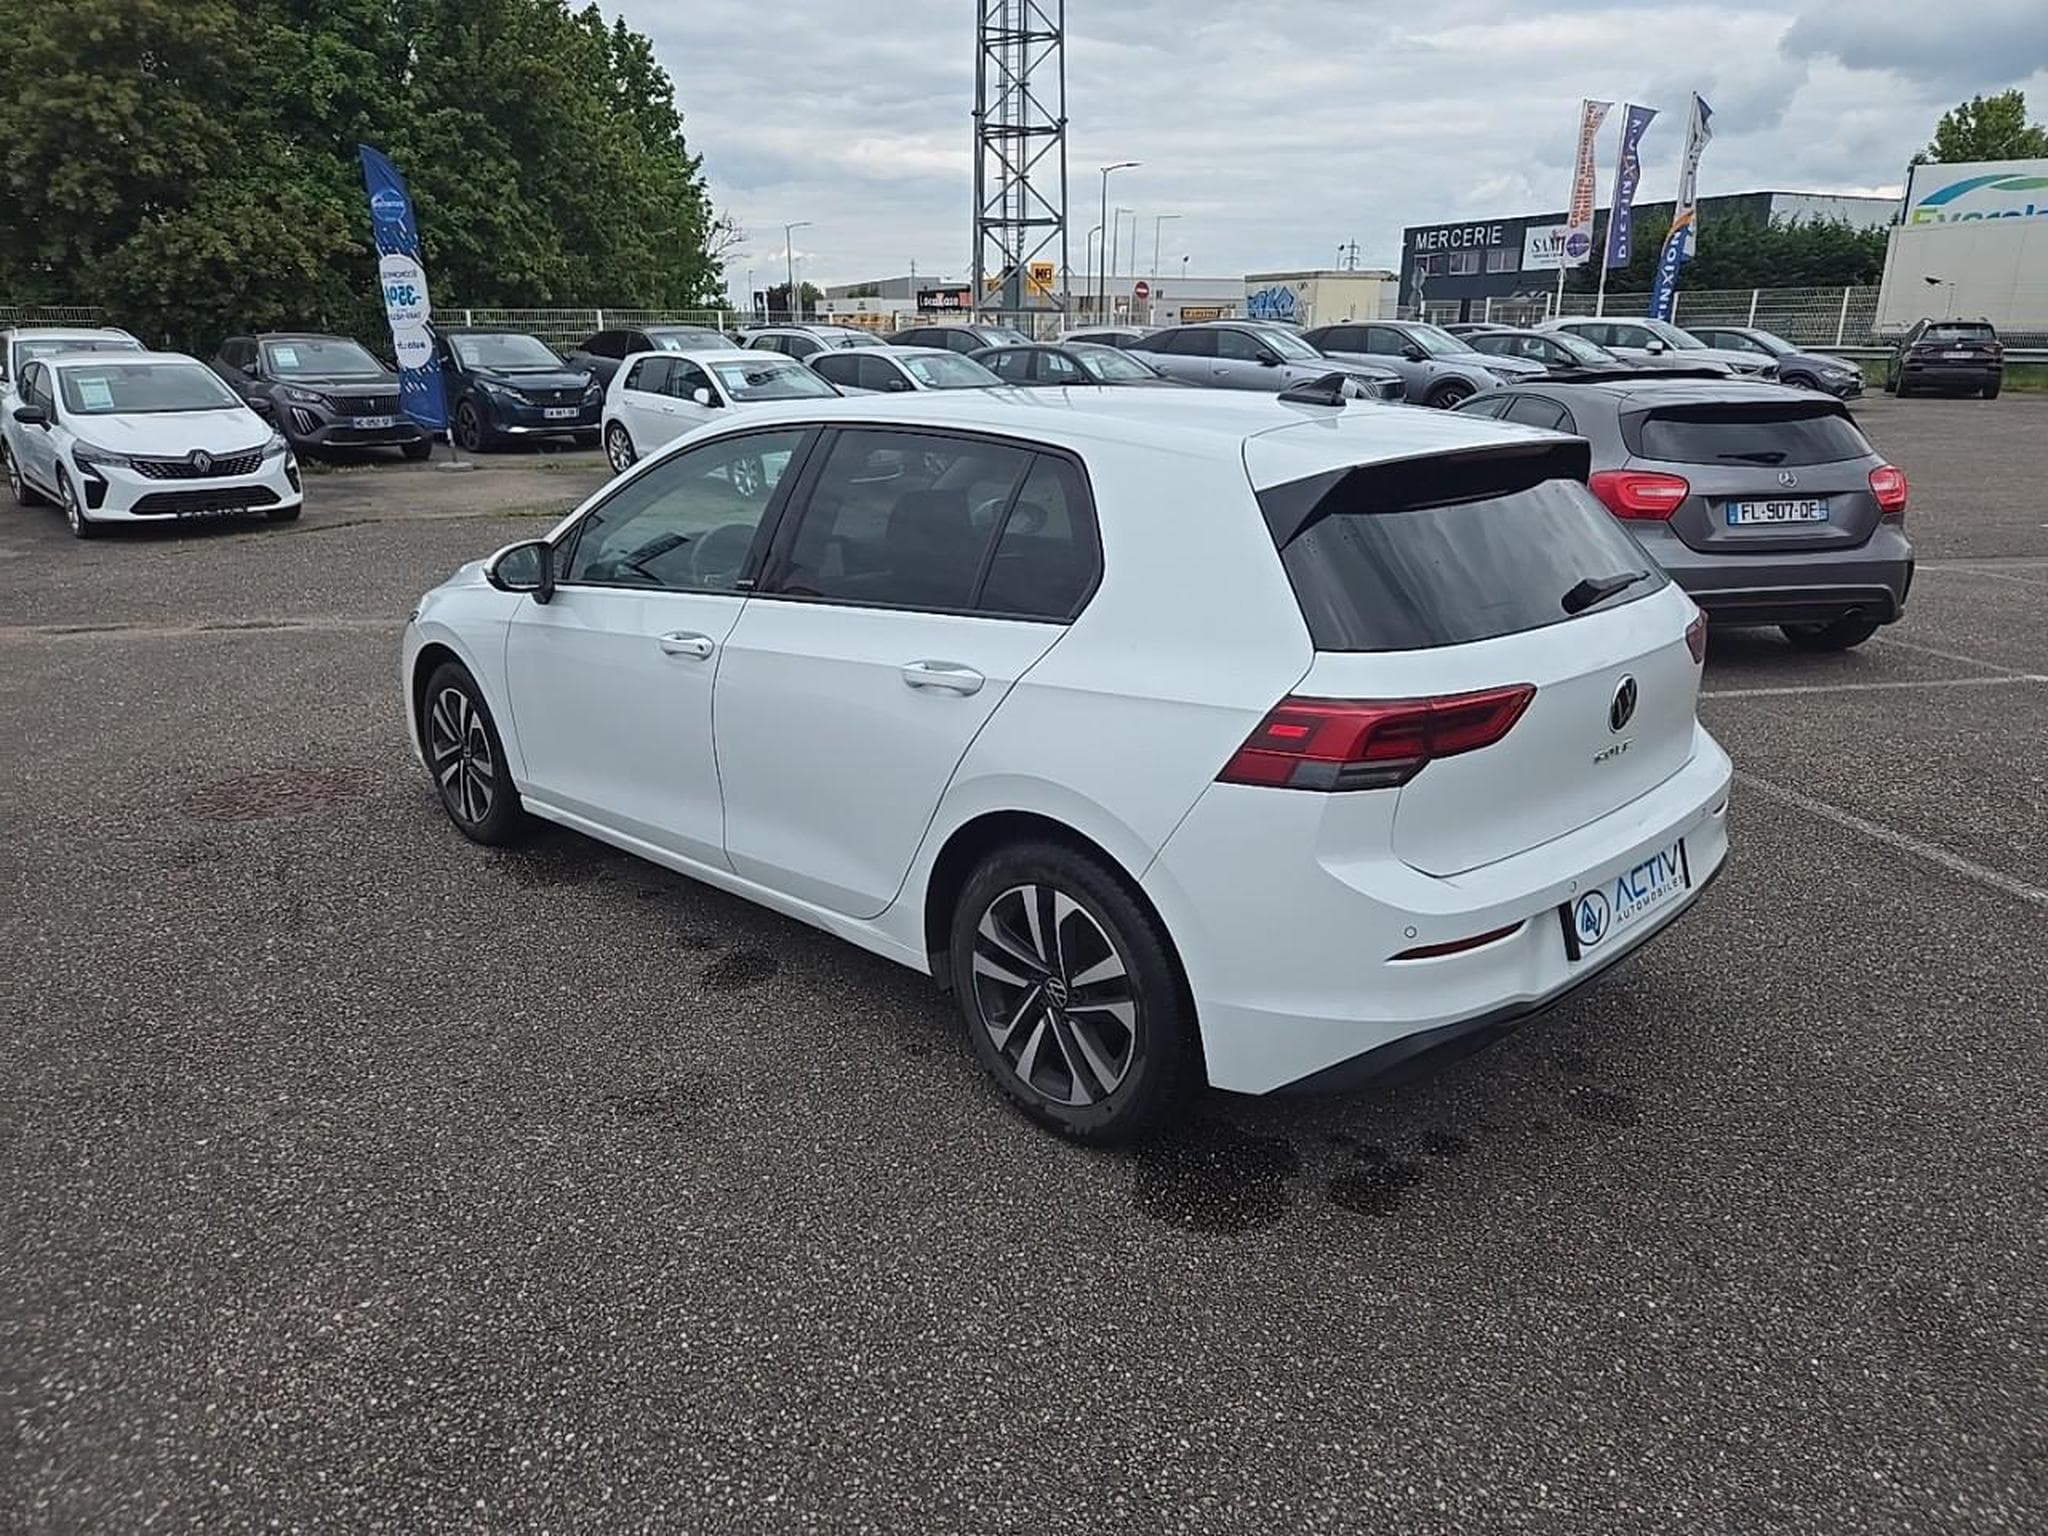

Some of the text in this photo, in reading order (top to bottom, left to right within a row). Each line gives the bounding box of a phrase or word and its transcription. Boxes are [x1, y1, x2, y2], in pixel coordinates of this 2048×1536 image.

[1414, 225, 1503, 251] MERCERIE
[1615, 844, 1678, 912] ACTIV
[1617, 874, 1684, 923] AUTOMOBILES
